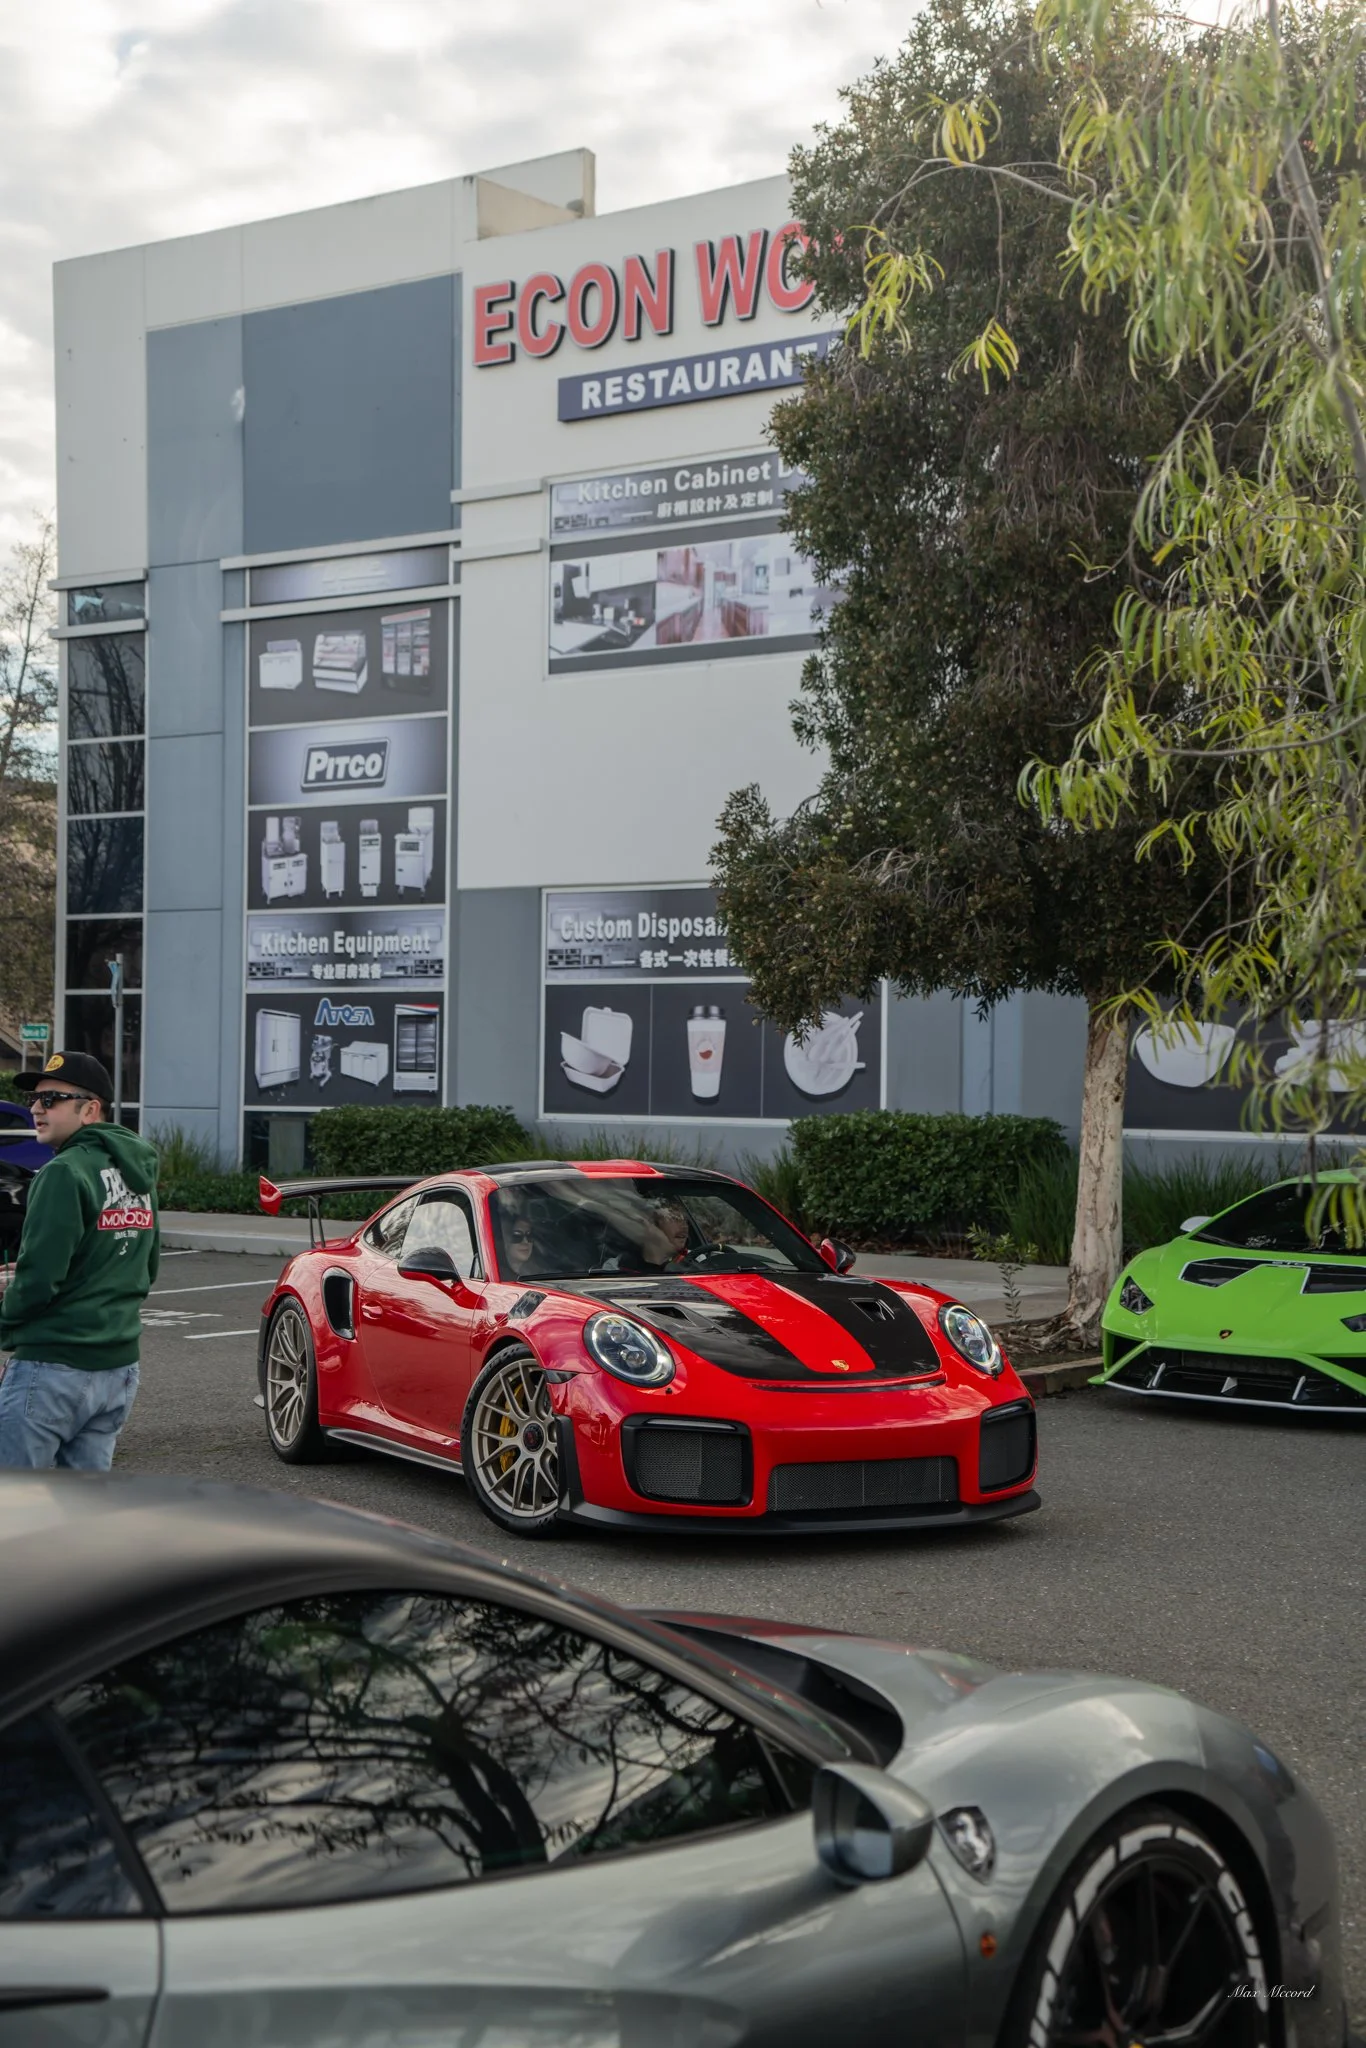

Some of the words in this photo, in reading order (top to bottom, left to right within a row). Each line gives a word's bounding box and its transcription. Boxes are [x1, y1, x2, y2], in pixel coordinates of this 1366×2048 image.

[474, 248, 674, 368] ECON
[695, 219, 822, 327] WO
[582, 342, 818, 411] RESTAURANT
[577, 476, 668, 503] Kitchen
[674, 460, 772, 492] Cabinet
[261, 931, 329, 953] Kitchen
[334, 930, 430, 958] Equipment
[561, 913, 633, 940] Custom
